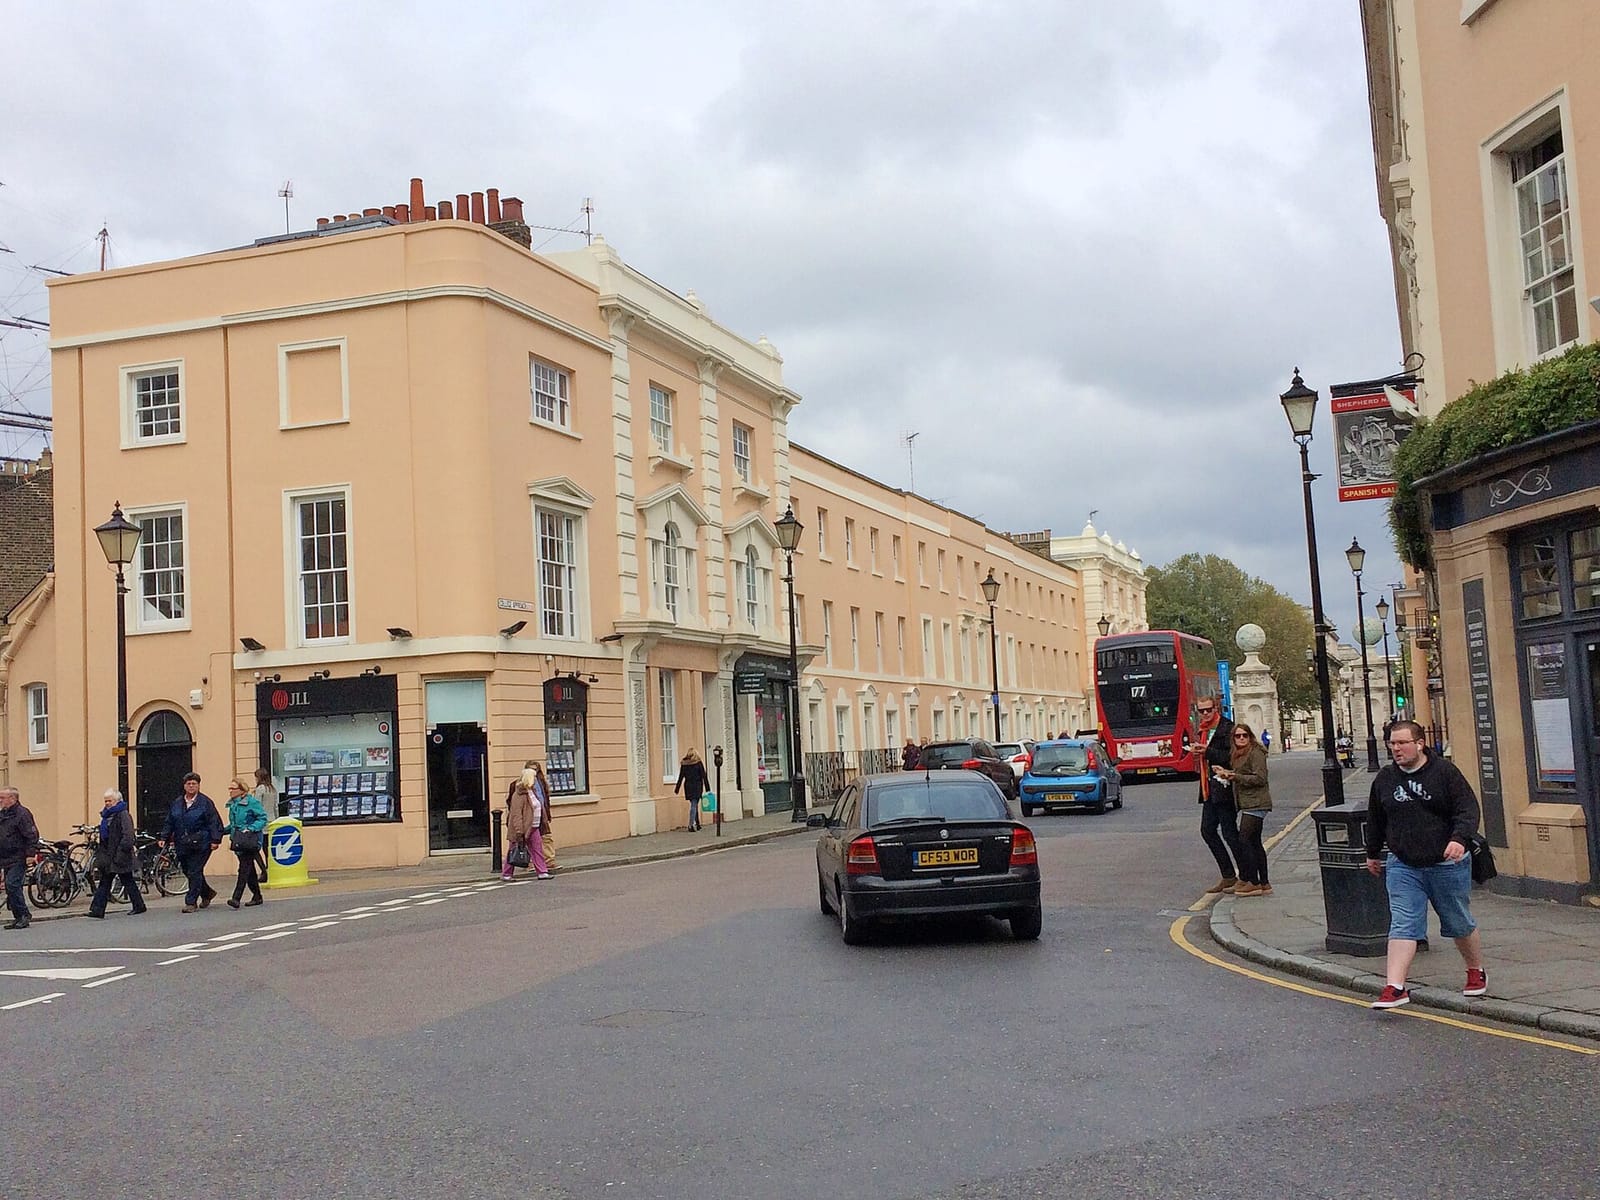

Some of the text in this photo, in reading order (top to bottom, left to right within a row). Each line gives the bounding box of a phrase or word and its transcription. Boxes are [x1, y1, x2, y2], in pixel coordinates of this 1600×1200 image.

[1337, 398, 1379, 409] SHEPHERD
[1344, 488, 1378, 498] SPANISH
[289, 691, 311, 706] JLL
[920, 851, 950, 864] CF53
